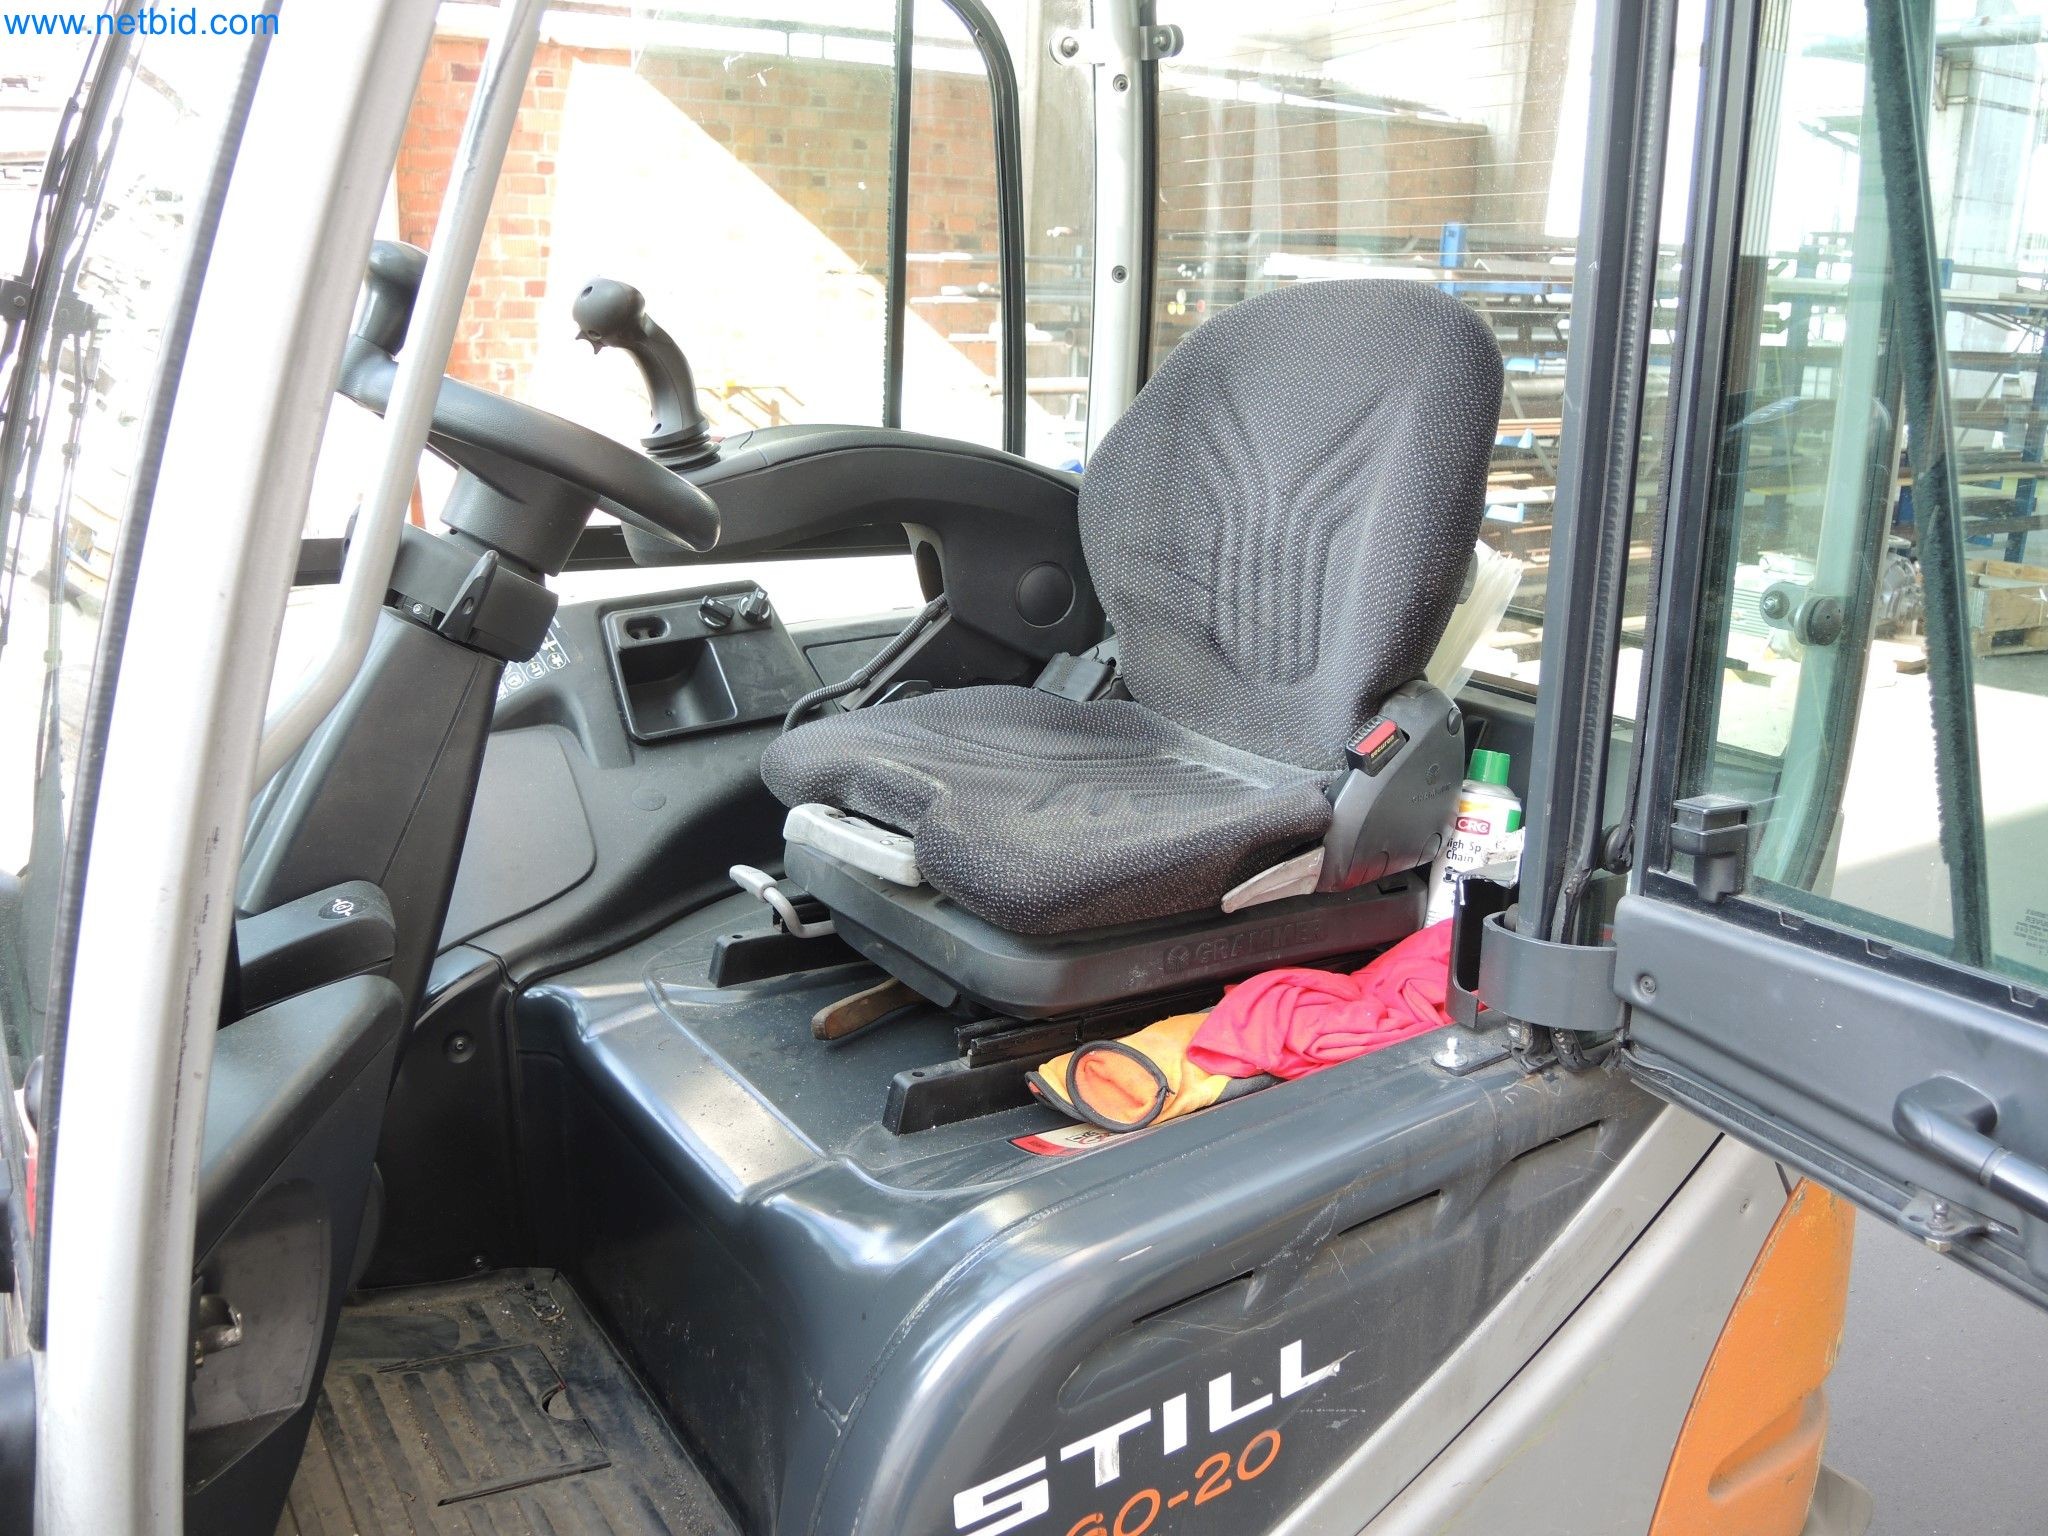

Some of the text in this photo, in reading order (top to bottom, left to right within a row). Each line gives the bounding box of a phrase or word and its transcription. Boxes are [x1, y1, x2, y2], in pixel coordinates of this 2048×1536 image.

[1458, 818, 1488, 834] CRC
[1446, 849, 1474, 863] Chain
[953, 1339, 1341, 1536] STILL
